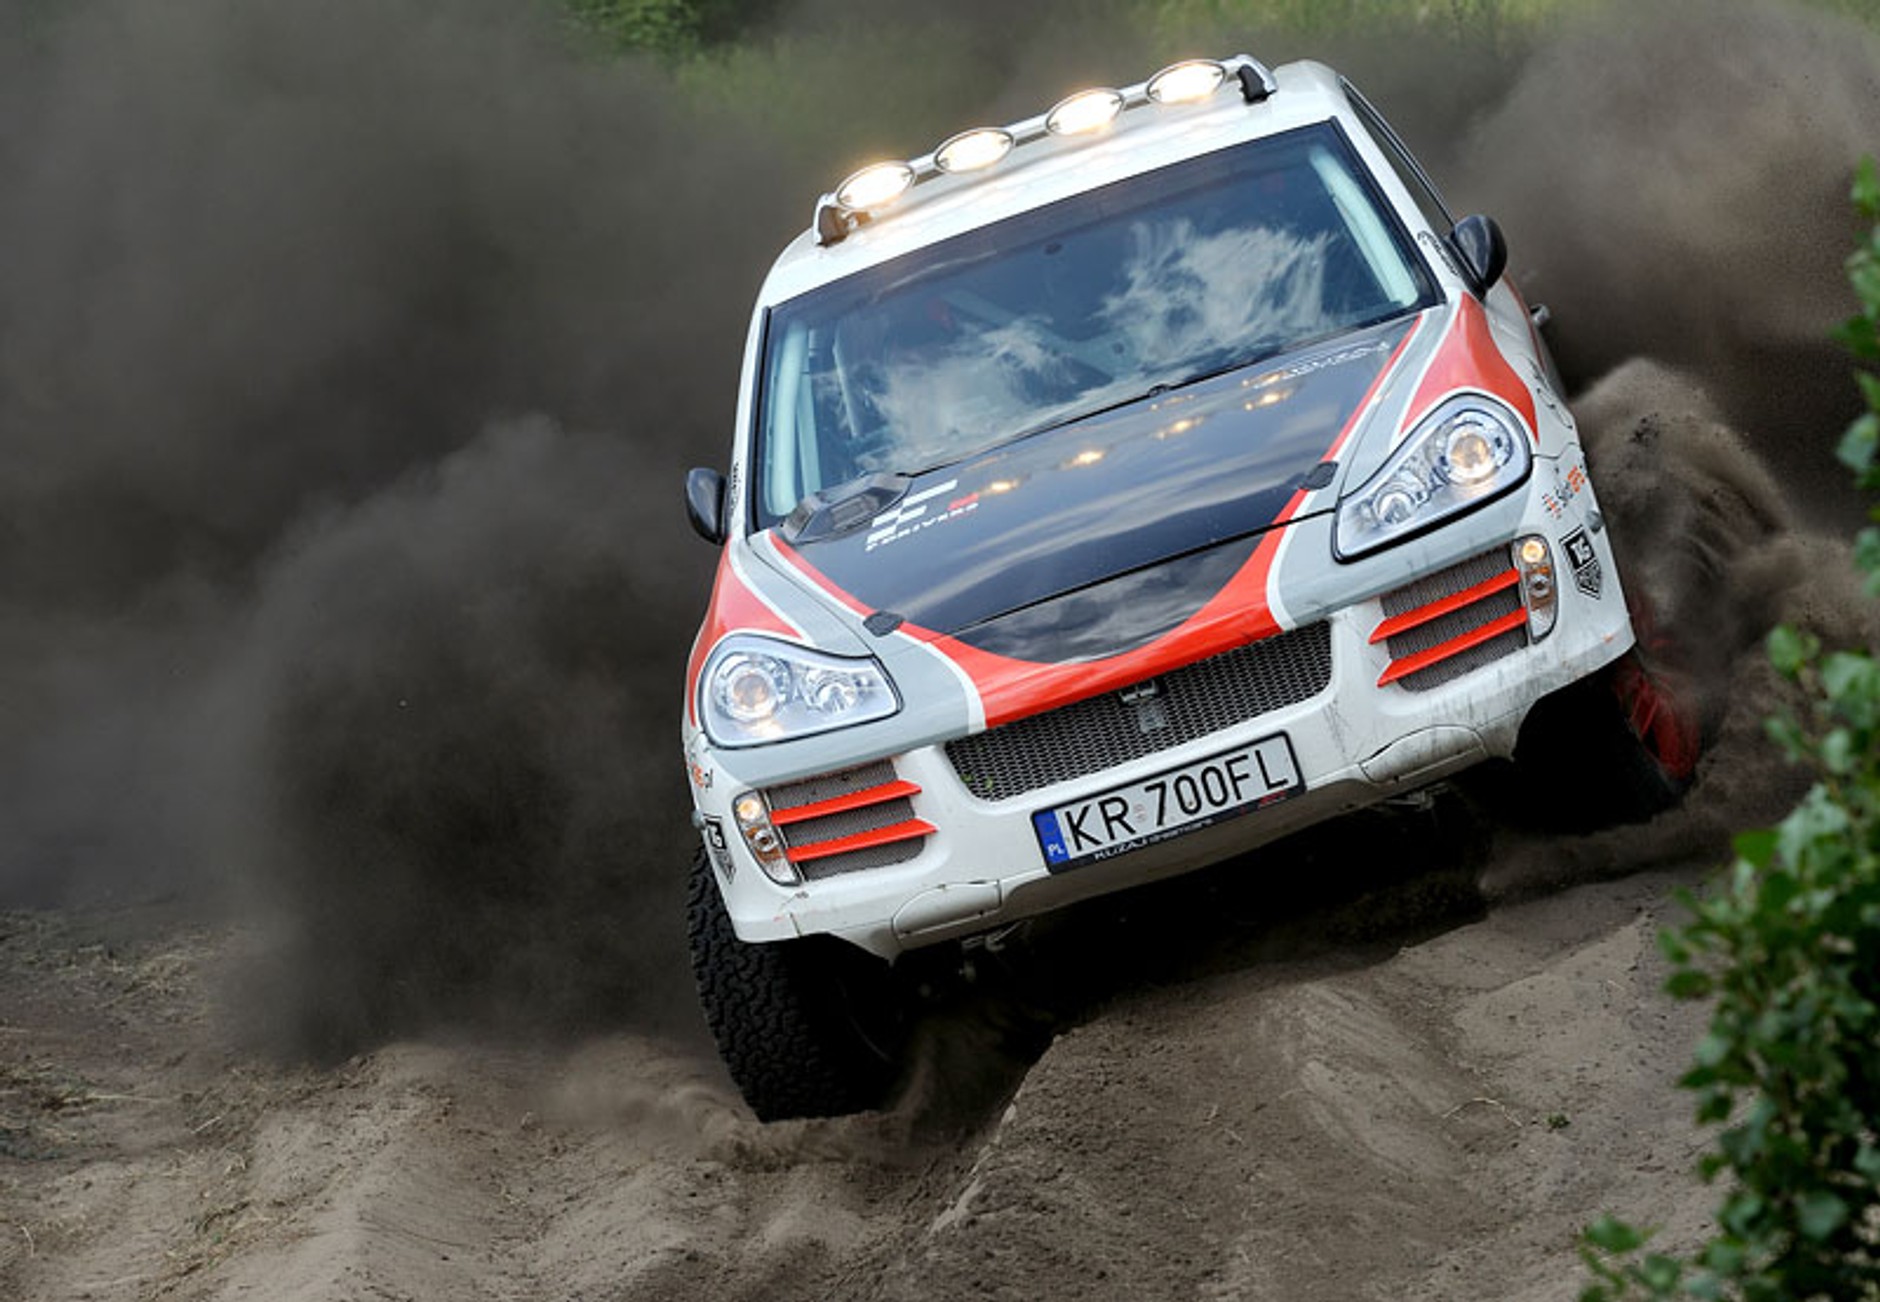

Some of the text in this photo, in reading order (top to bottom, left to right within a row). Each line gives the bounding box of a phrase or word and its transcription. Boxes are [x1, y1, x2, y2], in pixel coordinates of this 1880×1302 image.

[1065, 796, 1136, 851] KR
[1144, 750, 1288, 827] 700FL
[1048, 843, 1066, 856] PL
